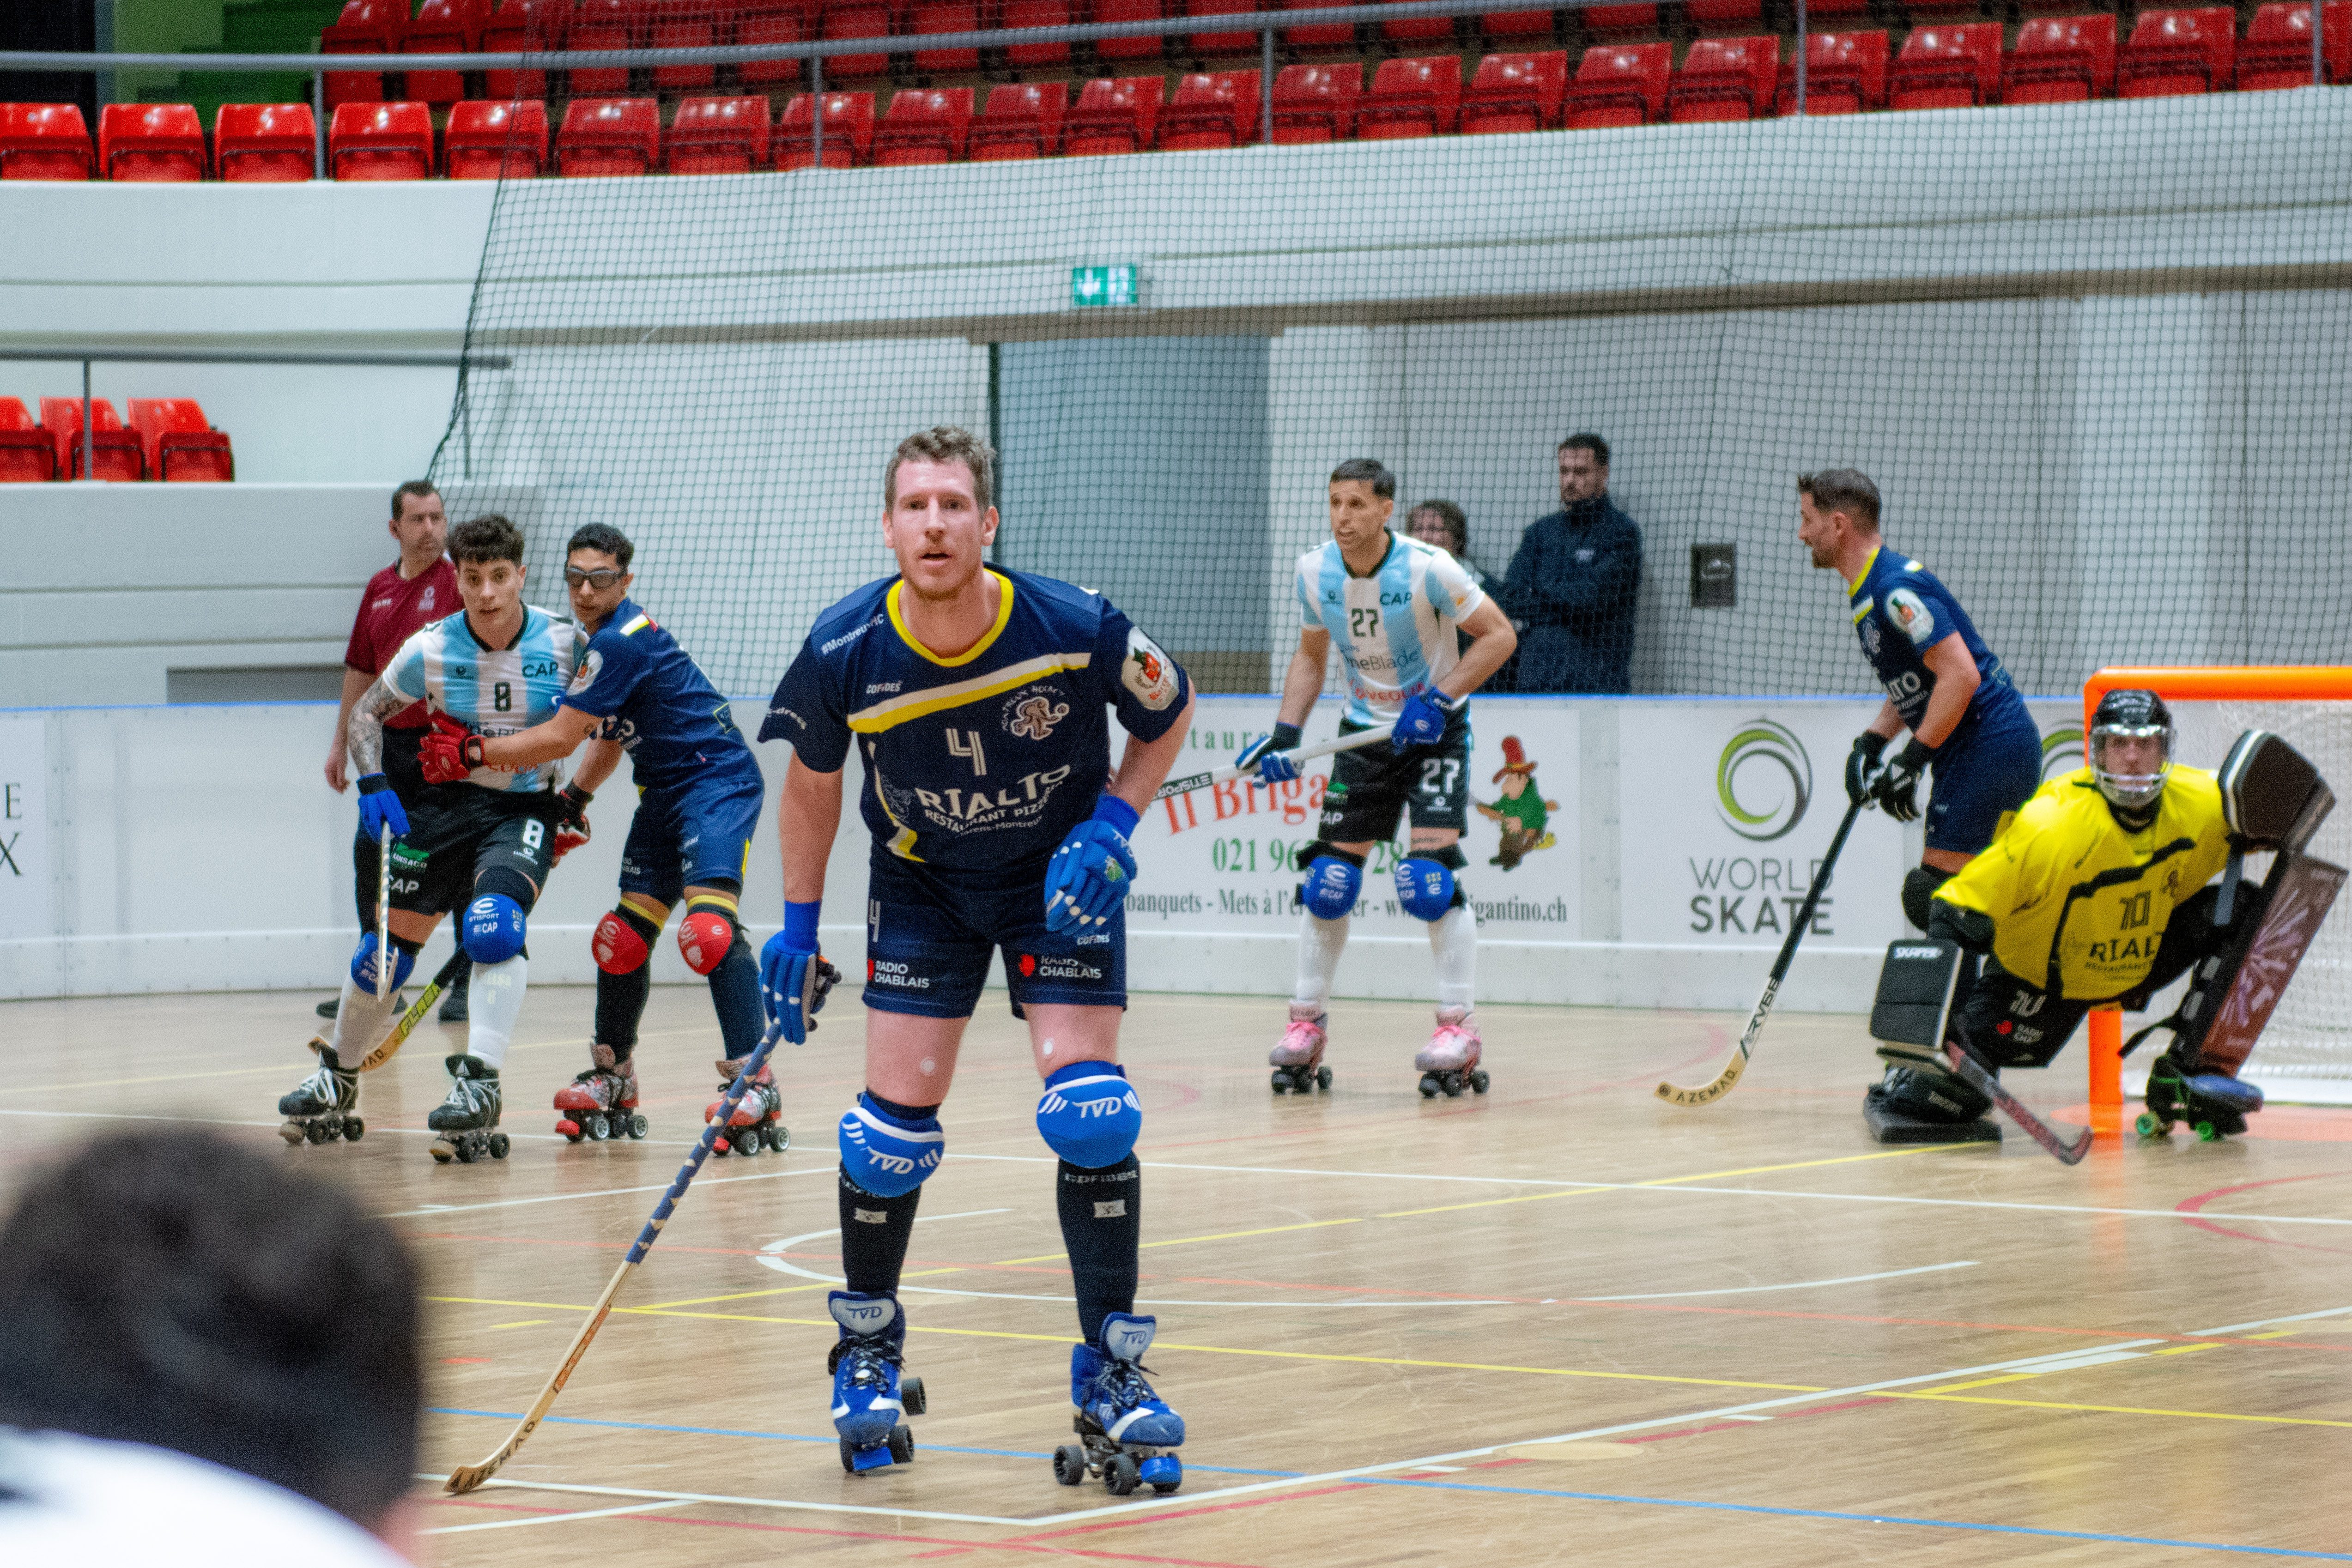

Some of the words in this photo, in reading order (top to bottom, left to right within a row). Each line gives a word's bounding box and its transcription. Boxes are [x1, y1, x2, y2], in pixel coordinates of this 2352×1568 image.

[1380, 592, 1412, 606] CAP
[1352, 608, 1378, 638] 27
[522, 661, 558, 678] CAP
[494, 682, 511, 712] 8
[866, 683, 901, 694] COFIDES
[946, 728, 987, 776] 4
[915, 764, 1071, 821] RIALTO
[1422, 758, 1460, 799] 27
[522, 818, 545, 849] 8
[1212, 837, 1256, 872] 021
[1689, 857, 1834, 891] WORLD
[1124, 890, 1201, 920] banquets
[1218, 889, 1258, 915] Mets
[1263, 889, 1273, 915] à
[1690, 895, 1834, 935] SKATE
[482, 922, 497, 934] CAP
[875, 972, 930, 988] CHABLAIS
[876, 960, 909, 974] RADIO
[1040, 966, 1102, 979] CHABLAIS
[1676, 1069, 1737, 1103] AZEMAD
[1071, 1096, 1122, 1118] TVD
[860, 1145, 915, 1174] TVD
[846, 1306, 882, 1320] TVD
[1121, 1331, 1147, 1344] TVD
